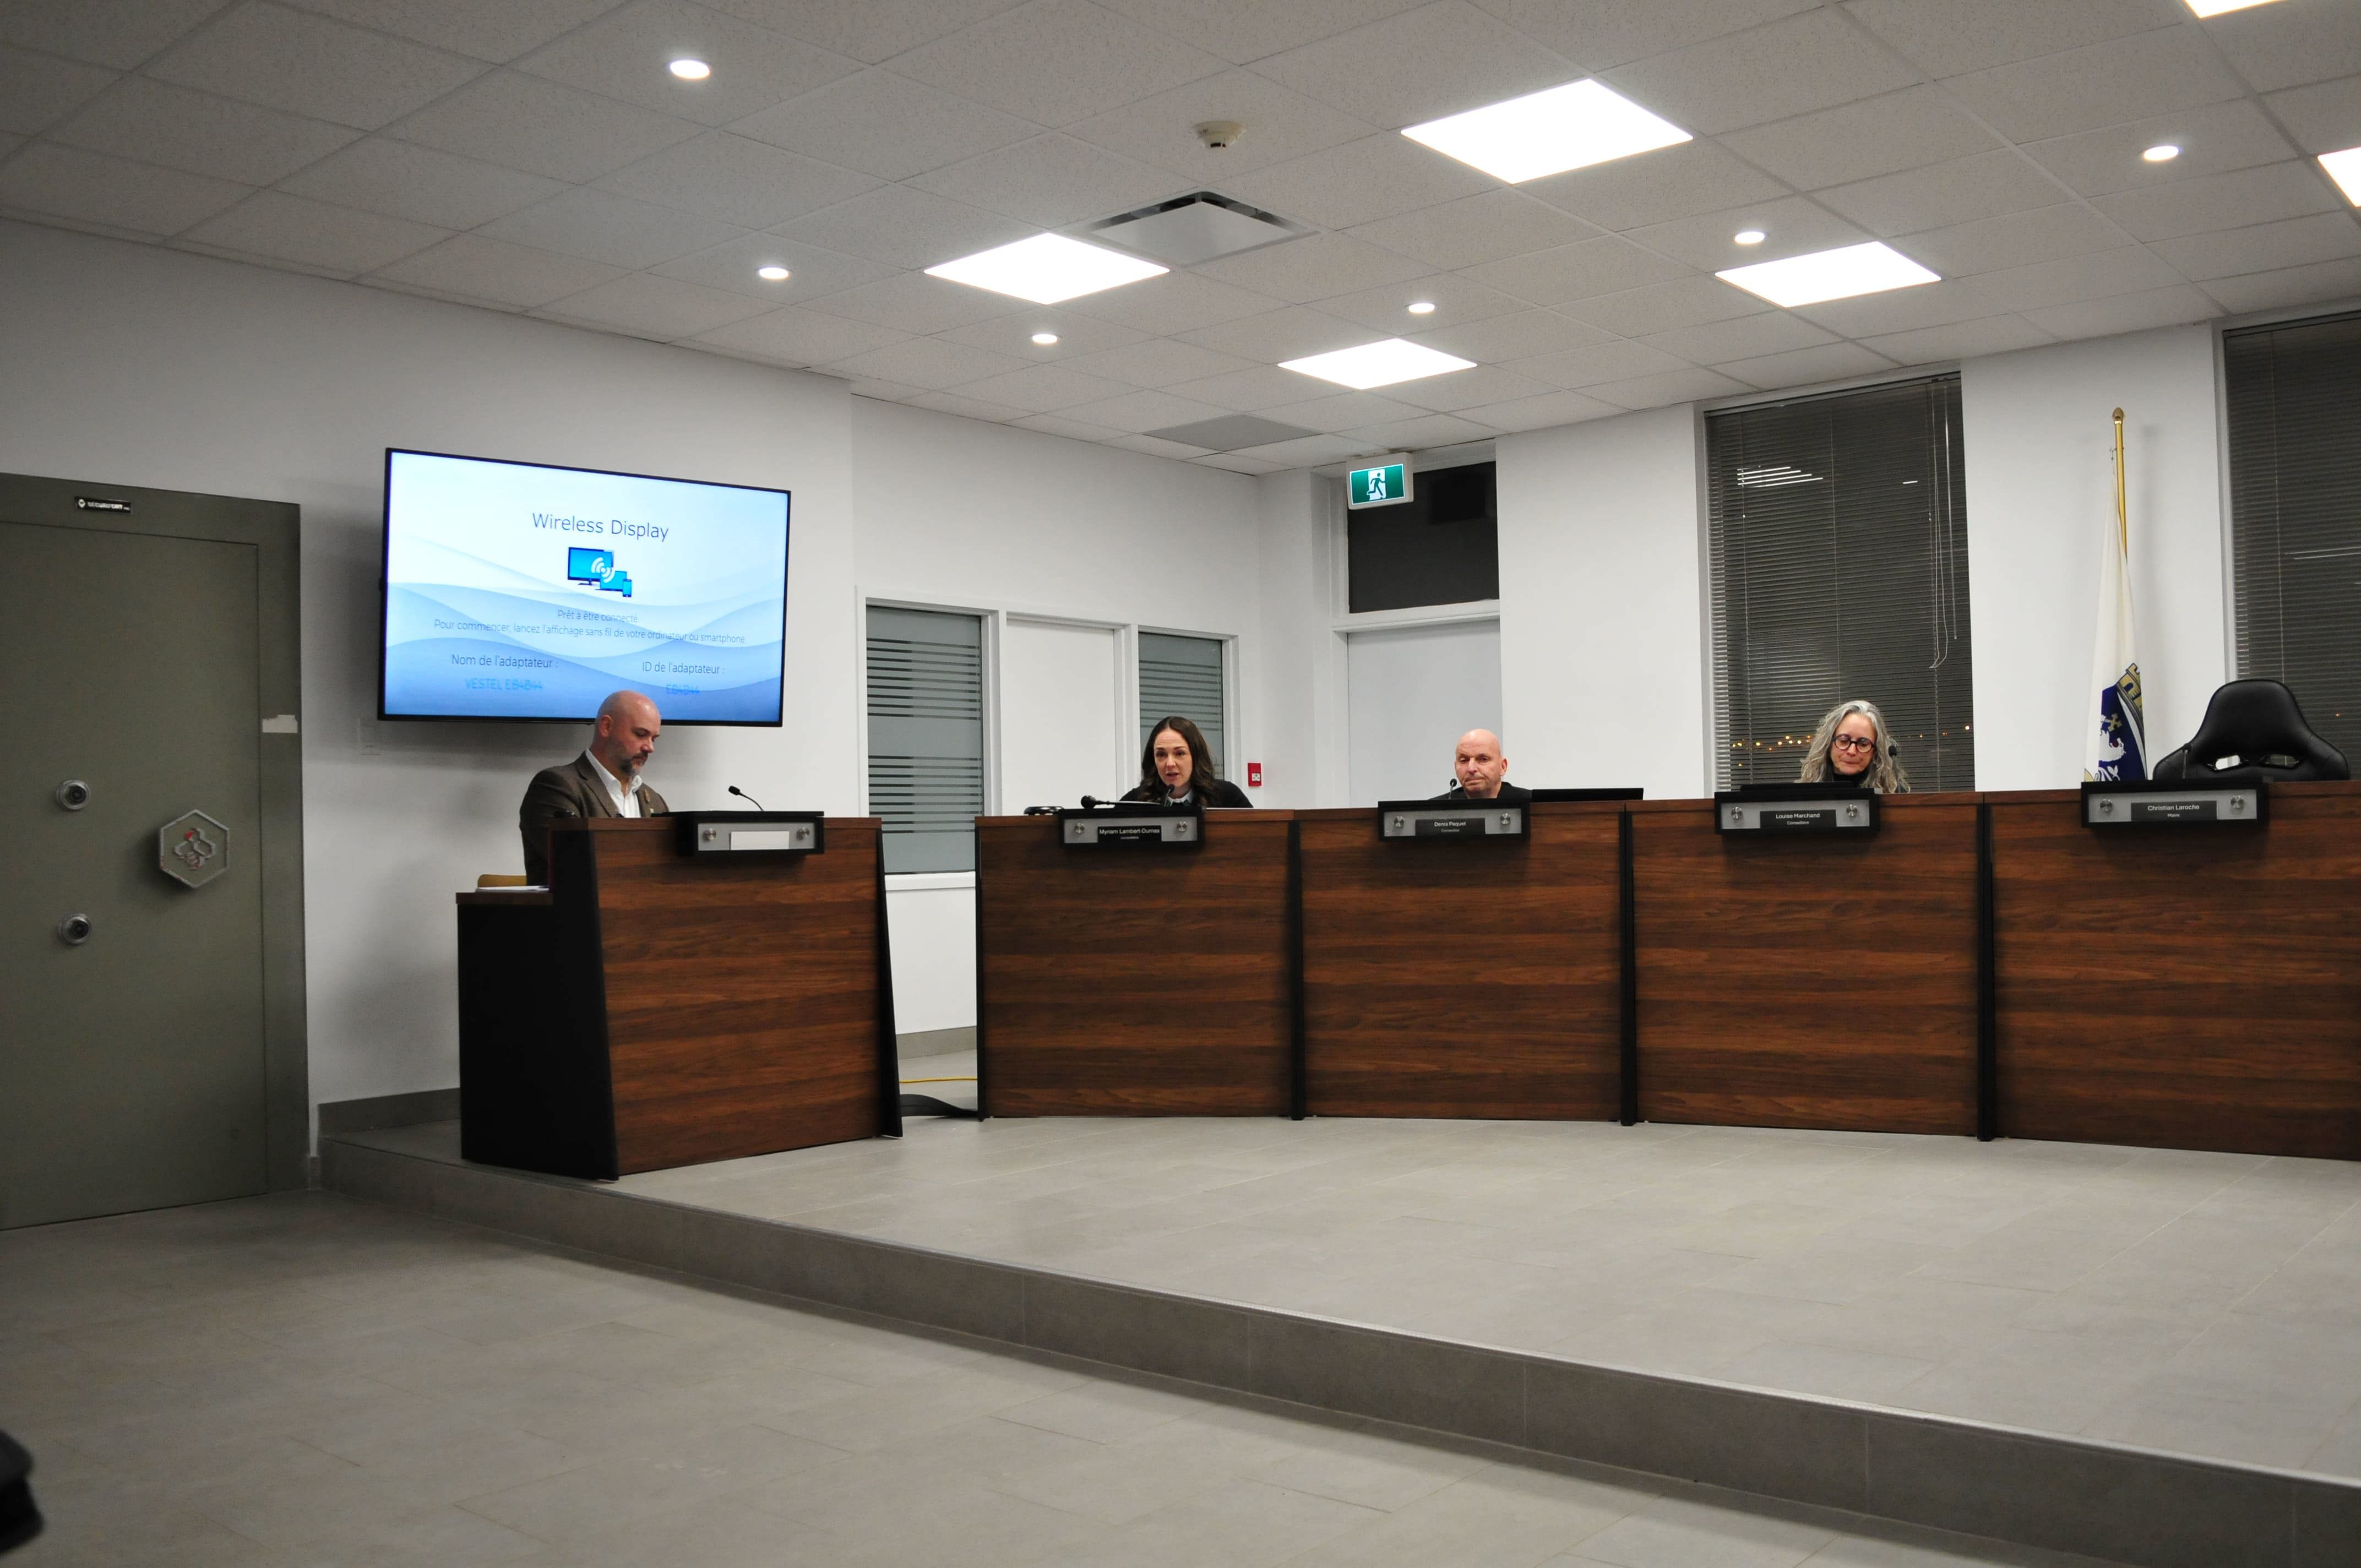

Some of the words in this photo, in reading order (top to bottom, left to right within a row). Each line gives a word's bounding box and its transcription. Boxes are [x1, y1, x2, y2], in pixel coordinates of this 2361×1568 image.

[532, 513, 603, 533] Wireless
[611, 520, 669, 542] Display
[557, 609, 574, 620] Prêt
[583, 611, 599, 621] être
[434, 619, 454, 630] Pour
[457, 623, 511, 633] commencer,
[514, 623, 540, 634] lancez
[543, 624, 584, 637] l'affichage
[586, 629, 602, 637] sans
[614, 628, 624, 638] de
[626, 630, 645, 639] votre
[648, 631, 687, 640] ordinateur
[451, 654, 476, 665] Nom
[480, 655, 492, 666] de
[494, 655, 553, 669] l'adaptateur
[642, 661, 652, 672] ID
[654, 662, 666, 672] de
[668, 662, 720, 675] l'adaptateur
[465, 678, 502, 689] VESTEL
